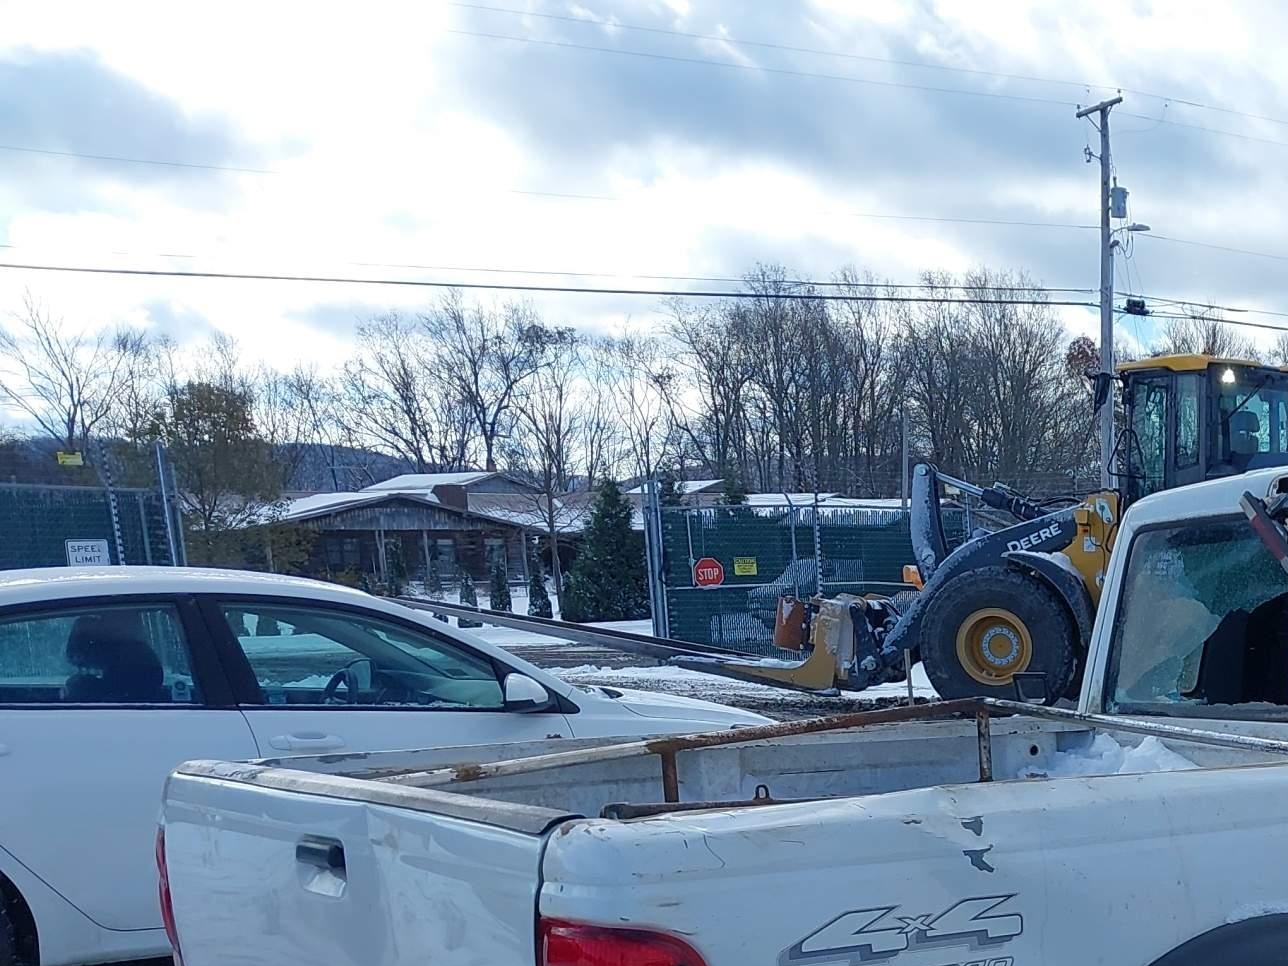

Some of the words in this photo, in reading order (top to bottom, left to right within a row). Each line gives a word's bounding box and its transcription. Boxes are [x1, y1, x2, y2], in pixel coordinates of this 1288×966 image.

[1006, 522, 1062, 553] DEERE
[75, 555, 102, 564] LIMIT
[698, 568, 719, 581] STOP
